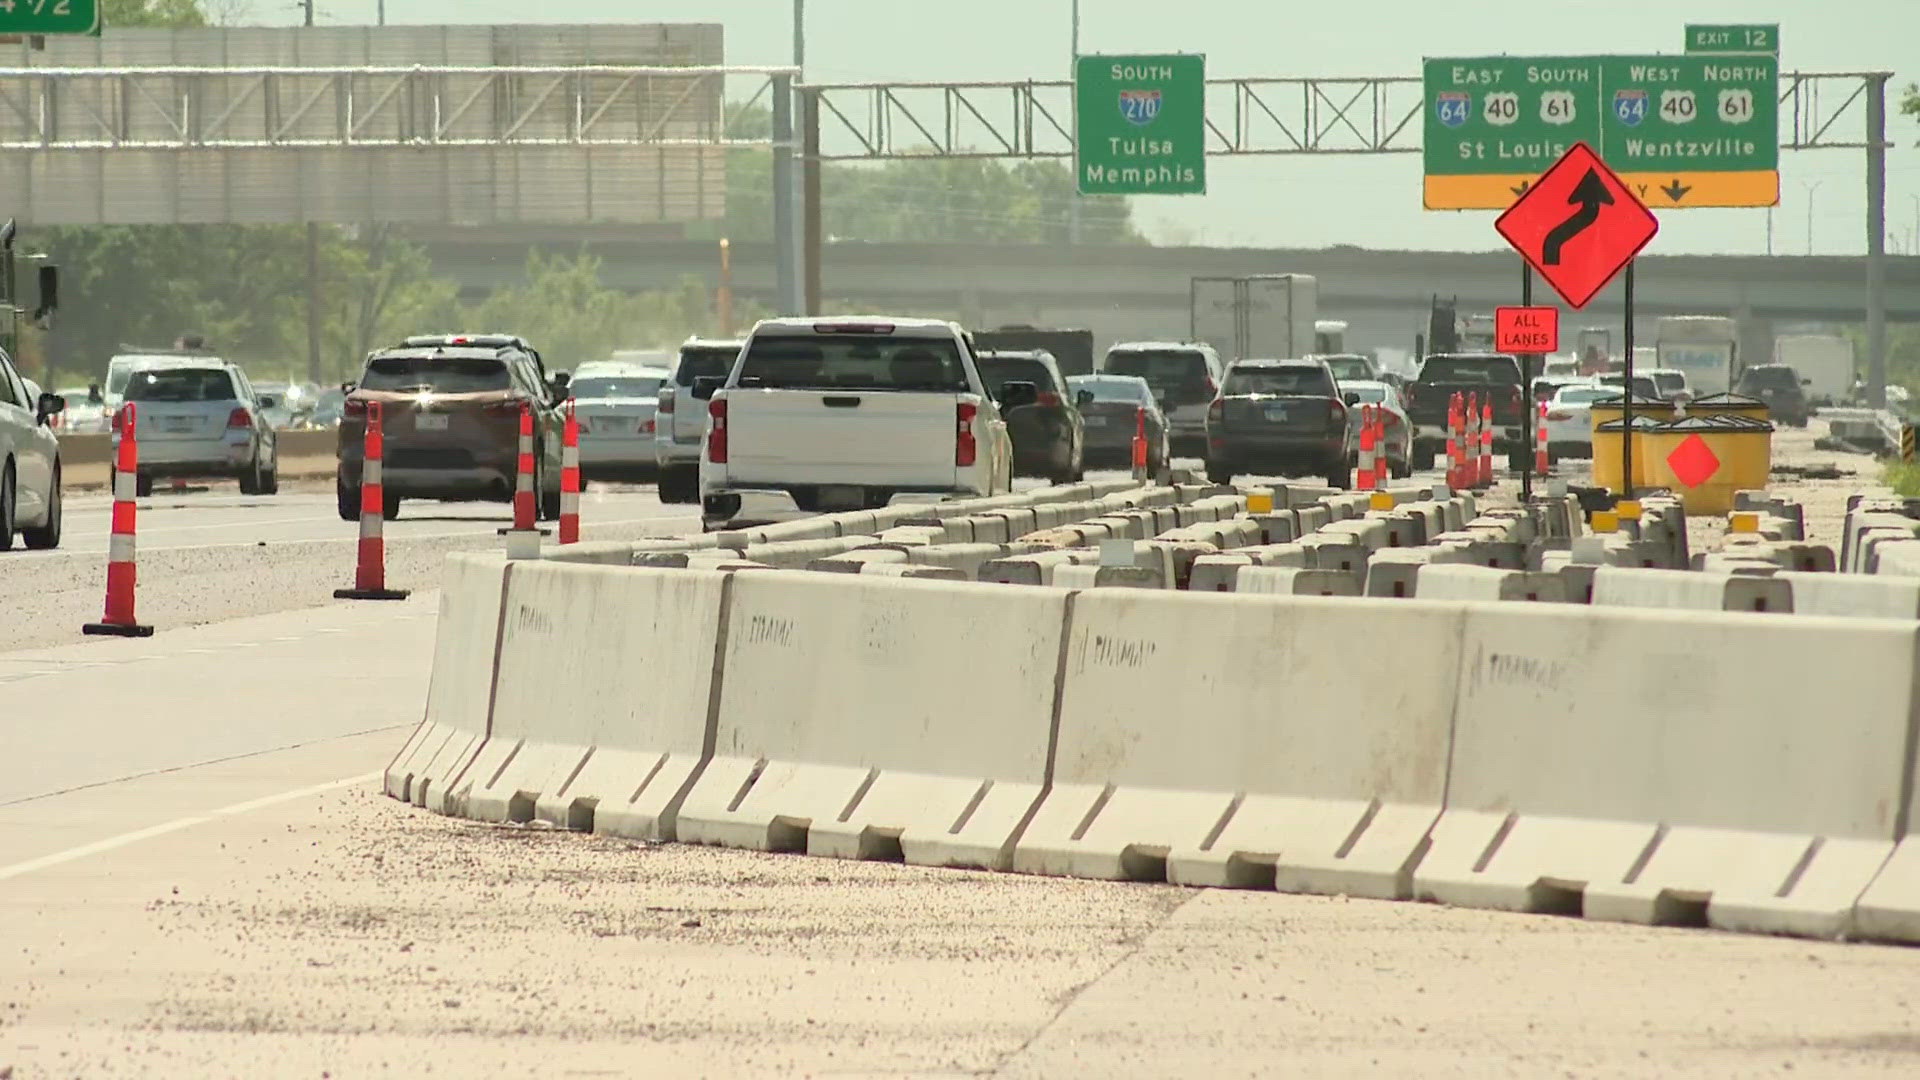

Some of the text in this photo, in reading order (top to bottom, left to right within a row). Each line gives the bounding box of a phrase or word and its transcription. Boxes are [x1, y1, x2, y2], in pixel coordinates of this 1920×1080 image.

[1697, 31, 1767, 46] EXIT 12
[1111, 64, 1172, 80] SOUTH
[1452, 65, 1588, 84] EAST SOUTH
[1630, 65, 1767, 82] WEST NORTH
[1126, 98, 1156, 118] 270
[1440, 98, 1569, 121] 64 40 61
[1619, 97, 1748, 120] 64 40 61
[1108, 137, 1174, 155] Tulsa
[1458, 140, 1565, 159] St Louis
[1626, 139, 1756, 157] Wentzville
[1086, 163, 1195, 186] Memphis
[1514, 314, 1540, 327] ALL
[1504, 333, 1549, 346] LANES
